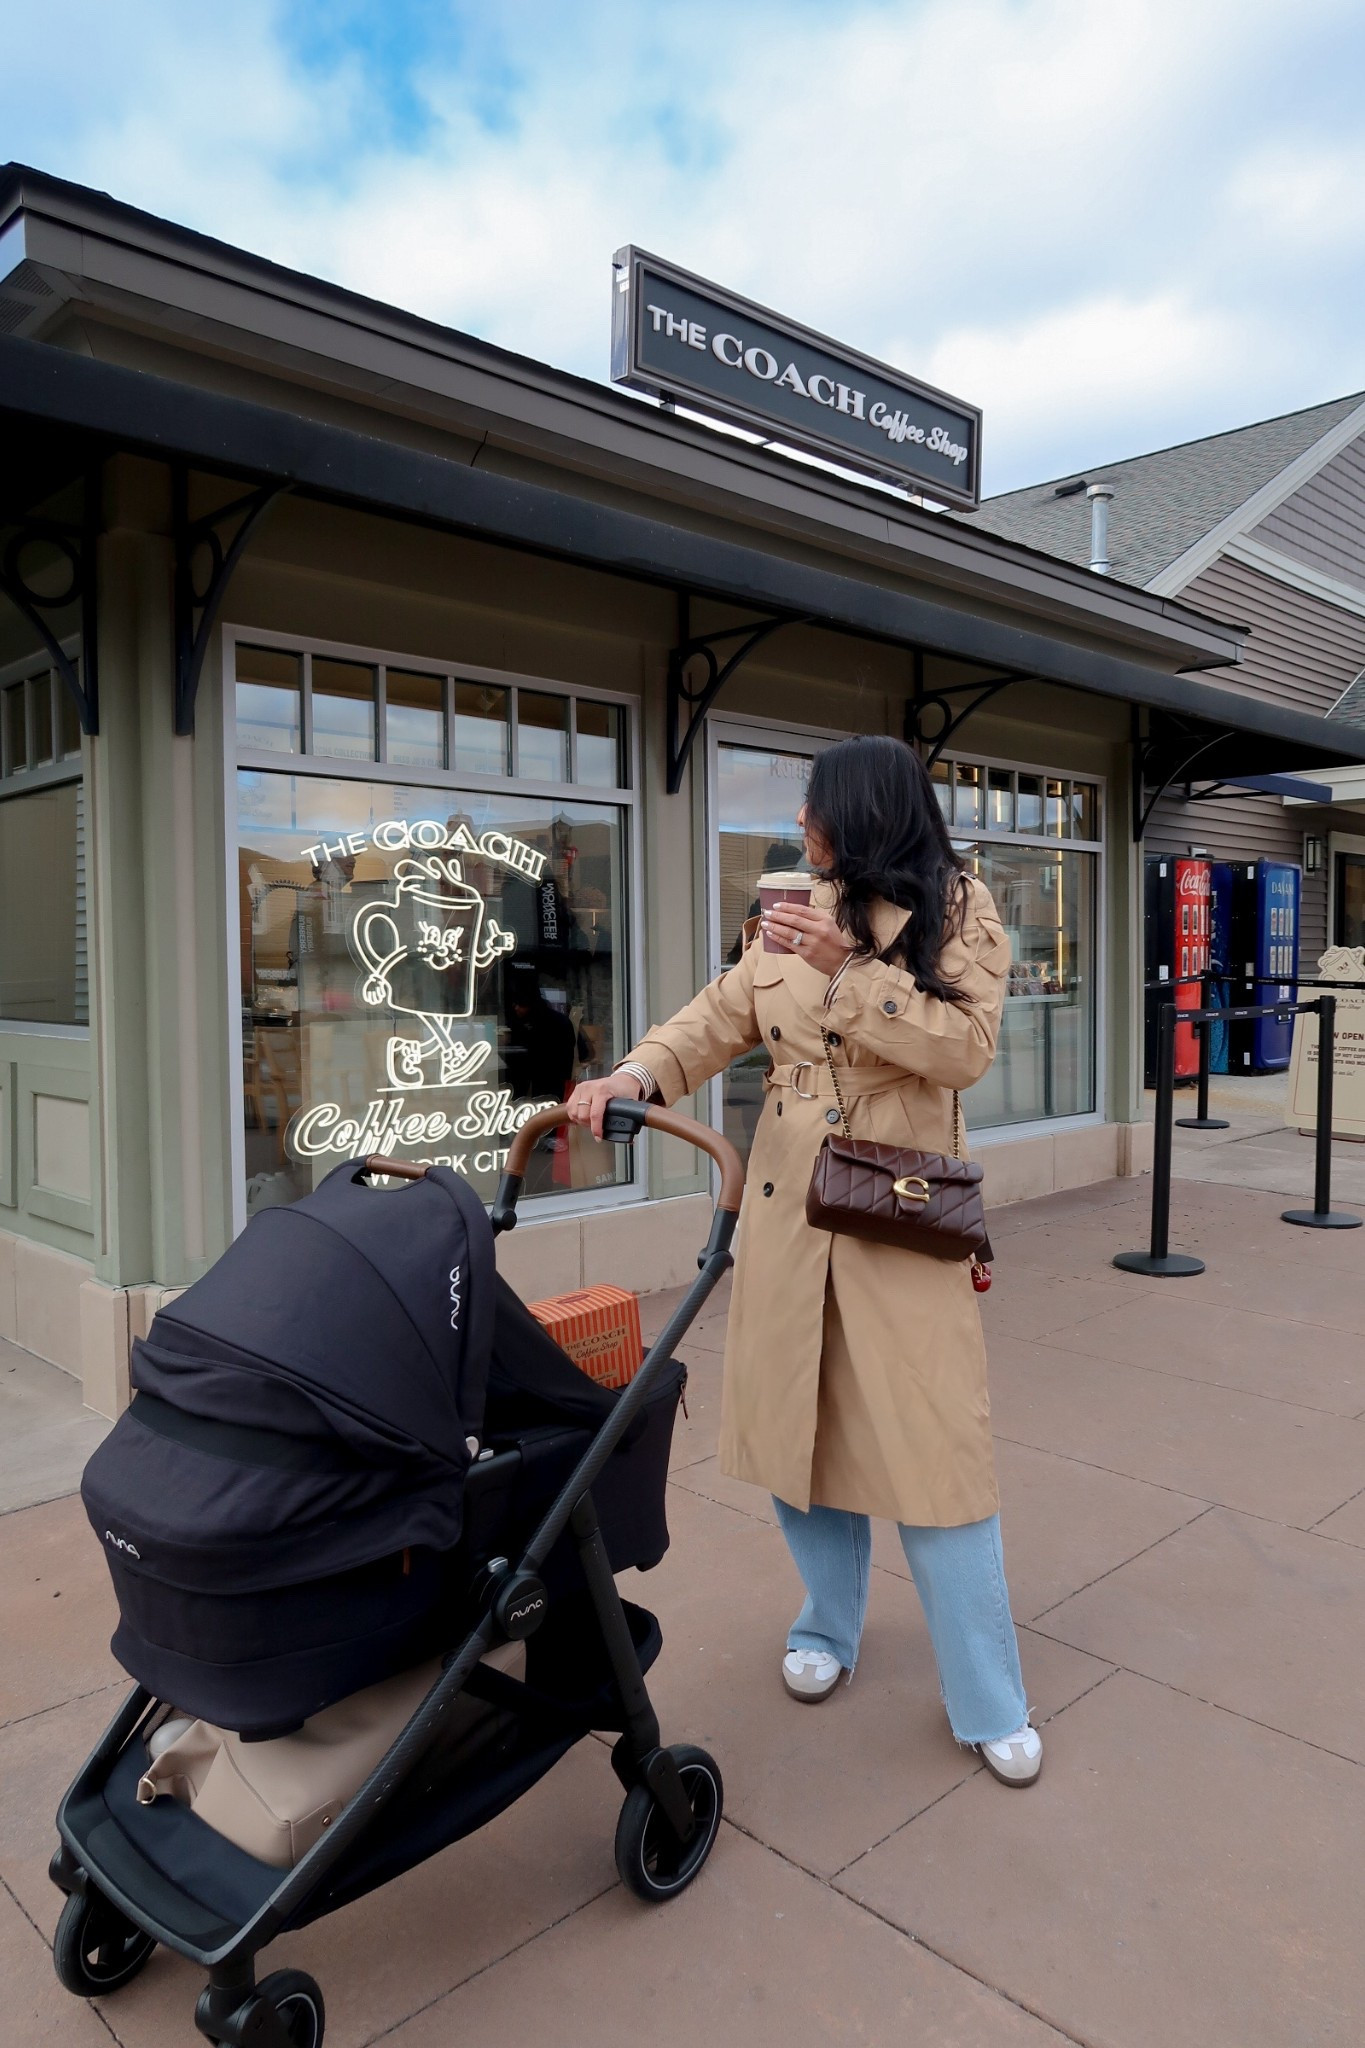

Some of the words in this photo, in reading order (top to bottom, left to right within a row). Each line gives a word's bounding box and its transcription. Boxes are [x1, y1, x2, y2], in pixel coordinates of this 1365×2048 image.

[647, 304, 707, 350] THE
[711, 333, 866, 420] COACH
[868, 402, 926, 443] Coffee
[926, 426, 968, 466] Shop
[301, 831, 368, 868] THE
[373, 820, 547, 881] COACH
[1342, 1032, 1364, 1041] OPEN
[294, 1097, 451, 1158] Coffee
[475, 1149, 510, 1173] CIT
[565, 1343, 581, 1351] THE
[582, 1328, 626, 1347] COACH
[576, 1346, 599, 1359] Coffee
[600, 1340, 618, 1351] Shop
[510, 1598, 543, 1621] nuna
